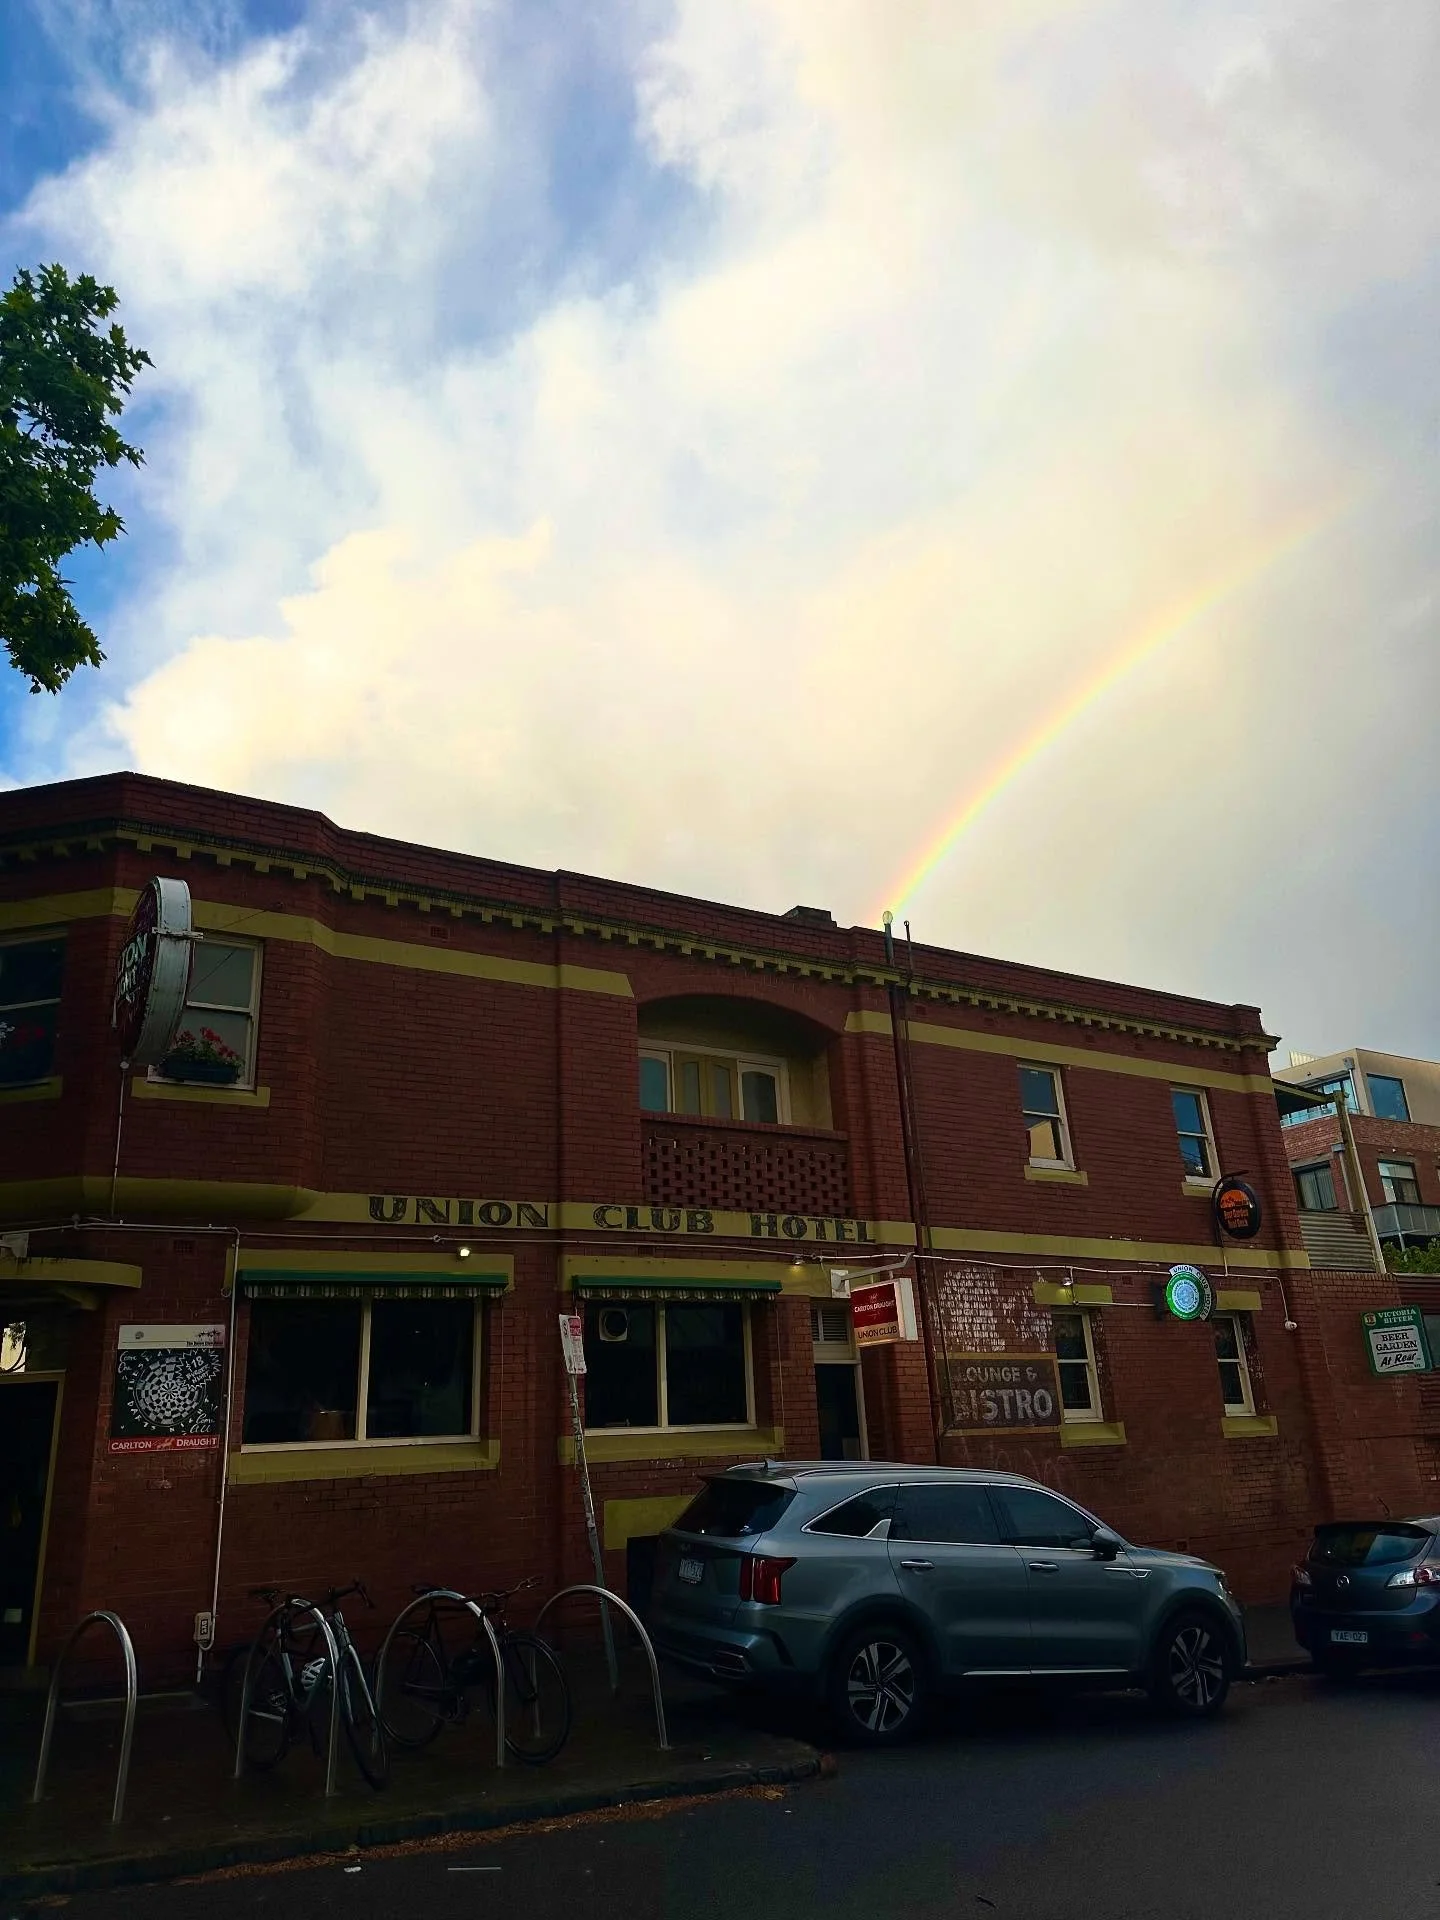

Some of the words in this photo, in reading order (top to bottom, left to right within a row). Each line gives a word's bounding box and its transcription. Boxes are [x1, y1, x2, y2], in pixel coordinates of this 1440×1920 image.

[368, 1195, 550, 1228] UNION
[592, 1204, 716, 1234] CLUB
[750, 1214, 876, 1244] HOTEL
[1173, 1265, 1193, 1273] UNION
[1377, 1308, 1416, 1318] VICTORIA
[1384, 1316, 1414, 1324] BITTER
[857, 1329, 879, 1339] UNION
[878, 1325, 898, 1336] CLUB
[1381, 1332, 1409, 1342] BEER
[1376, 1340, 1418, 1352] GARDEN
[1380, 1356, 1392, 1368] At
[1394, 1352, 1417, 1364] Rear
[952, 1366, 1021, 1383] OUNGE
[1025, 1366, 1038, 1382] &
[111, 1440, 152, 1450] CARLTON
[176, 1438, 217, 1447] DRAUGHT
